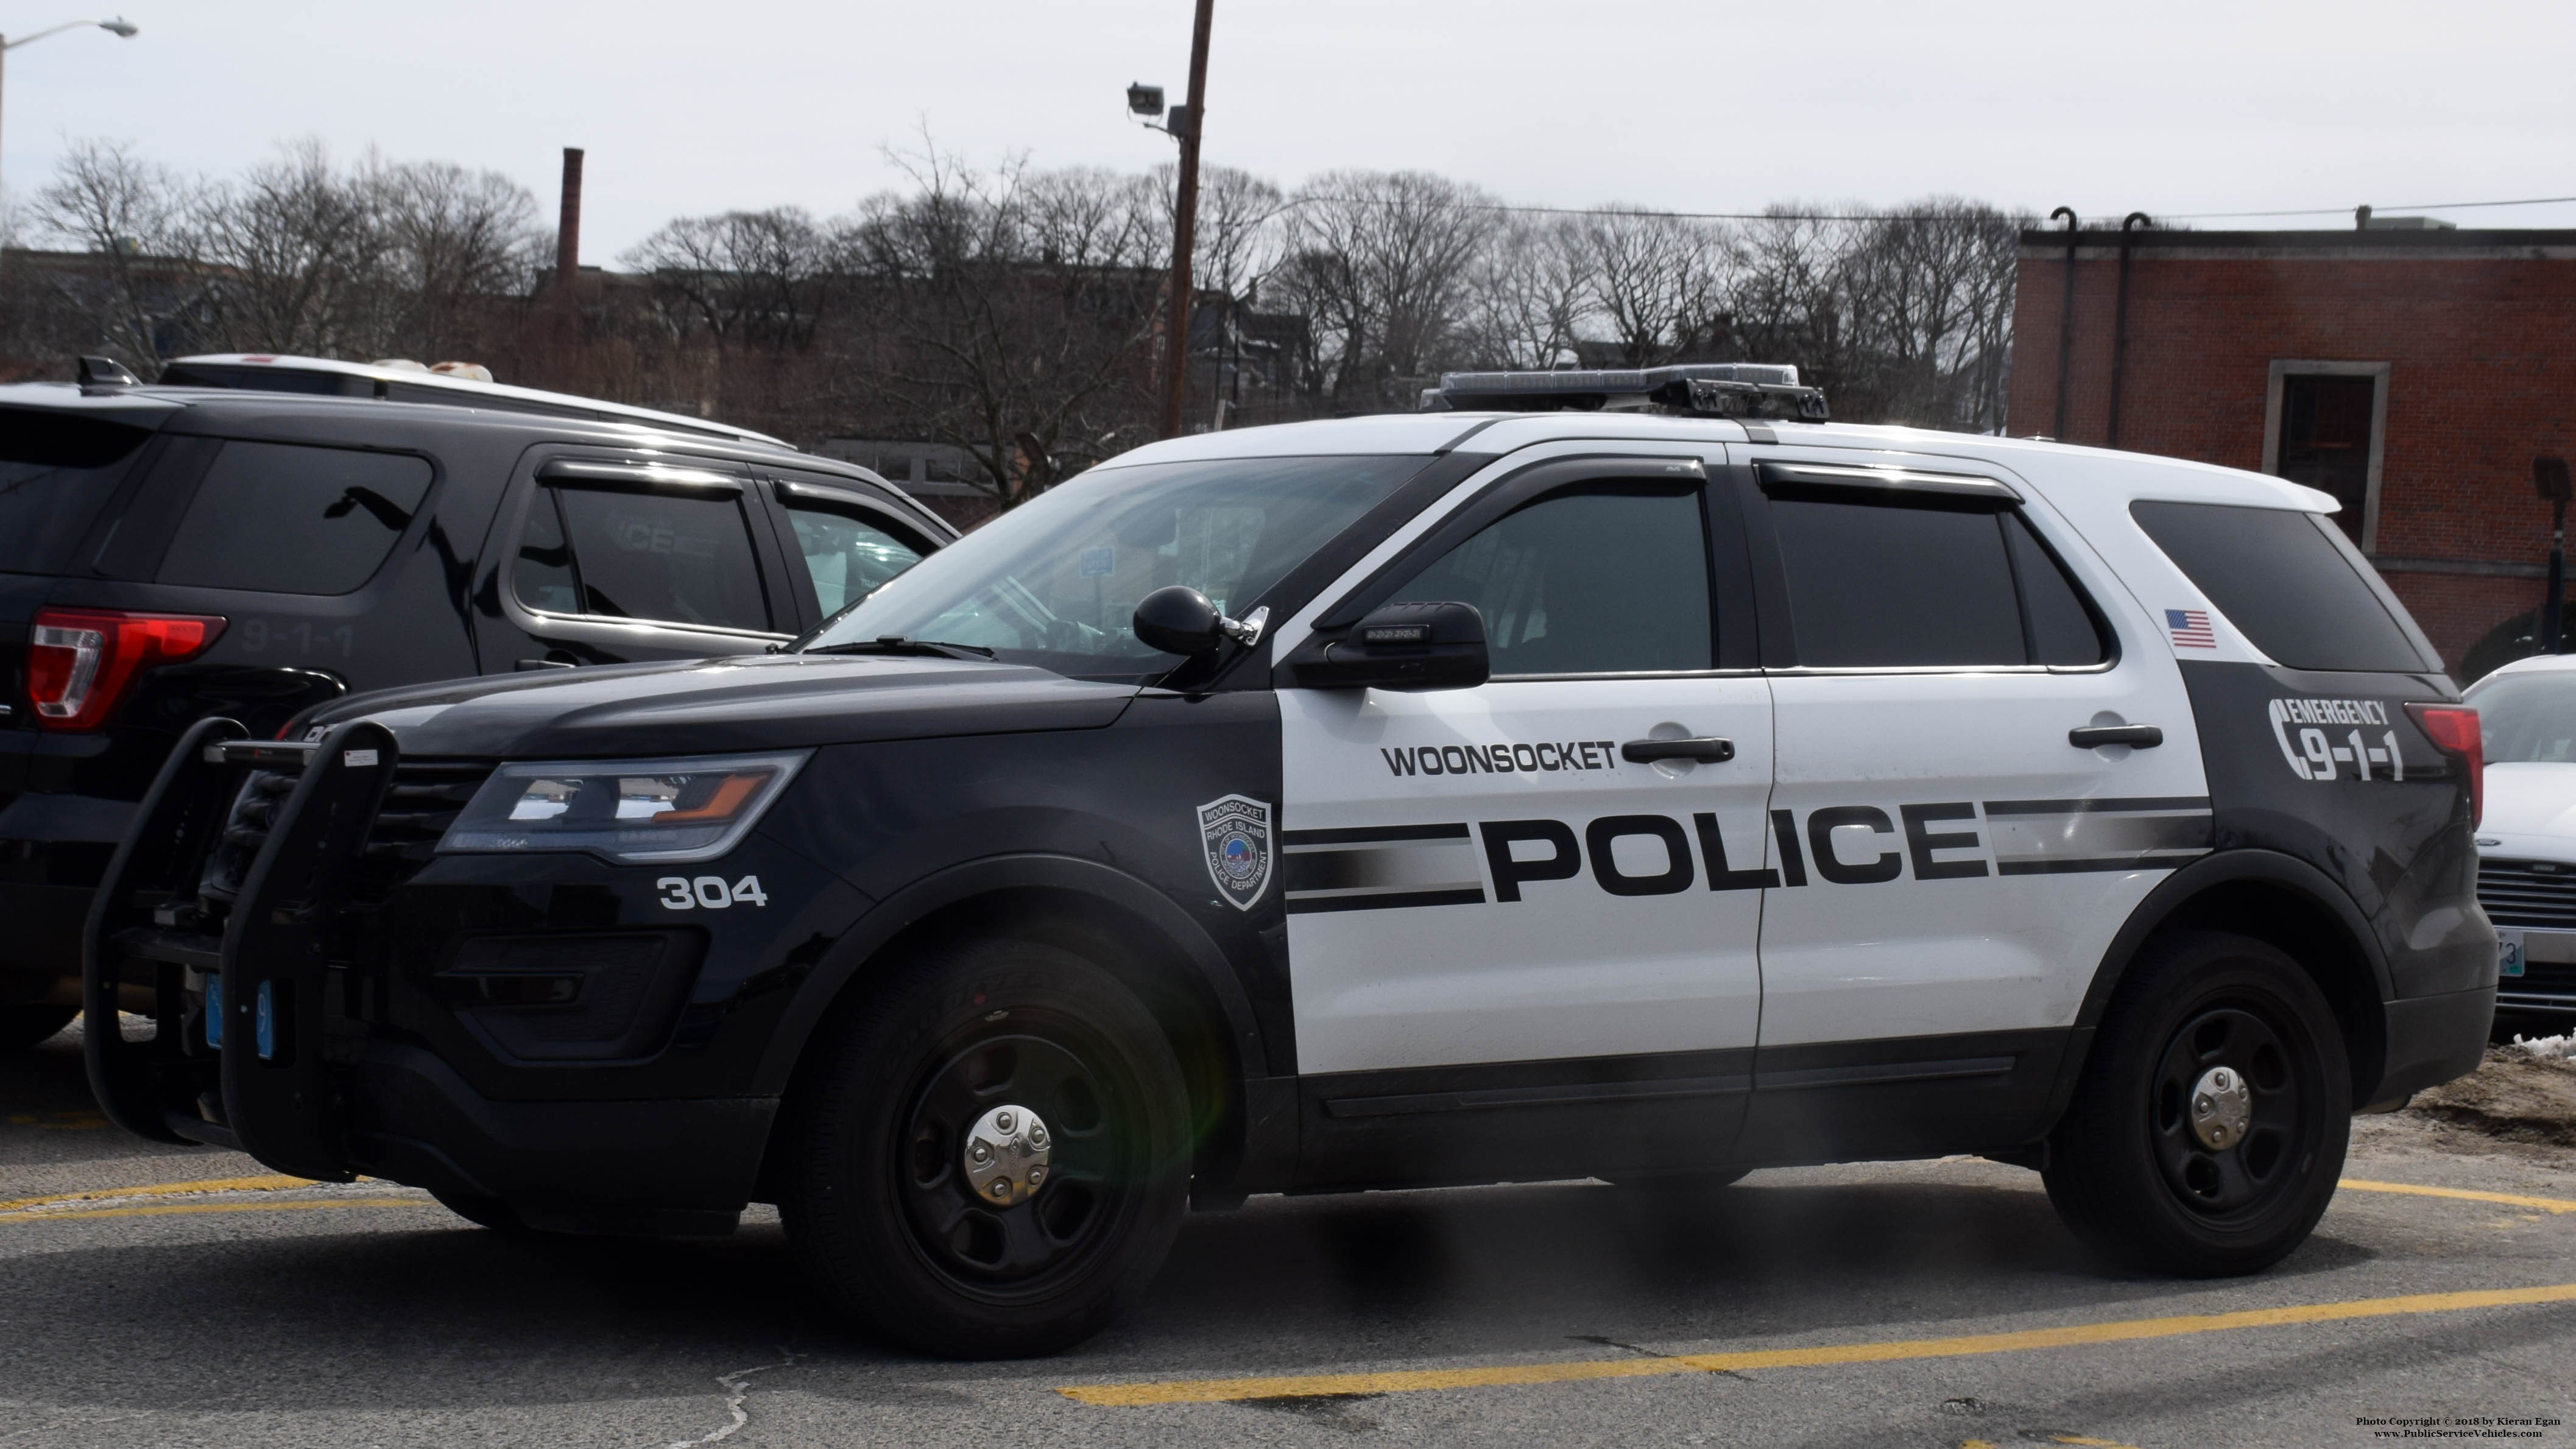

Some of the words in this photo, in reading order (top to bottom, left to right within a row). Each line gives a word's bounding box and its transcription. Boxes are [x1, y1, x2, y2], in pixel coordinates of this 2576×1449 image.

[241, 619, 354, 657] 9-1-1
[2287, 699, 2389, 725] EMERGENCY
[1380, 741, 1616, 777] WOONSOCKET
[2300, 728, 2404, 781] 9-1-1
[1205, 802, 1263, 822] WOONSOCKET
[1207, 820, 1233, 841] RHODE
[1235, 820, 1265, 839] ISLAND
[1210, 851, 1230, 886] POLICE
[1232, 850, 1267, 890] DEPARTMENT
[1479, 802, 1988, 903] POLICE
[657, 875, 769, 911] 304
